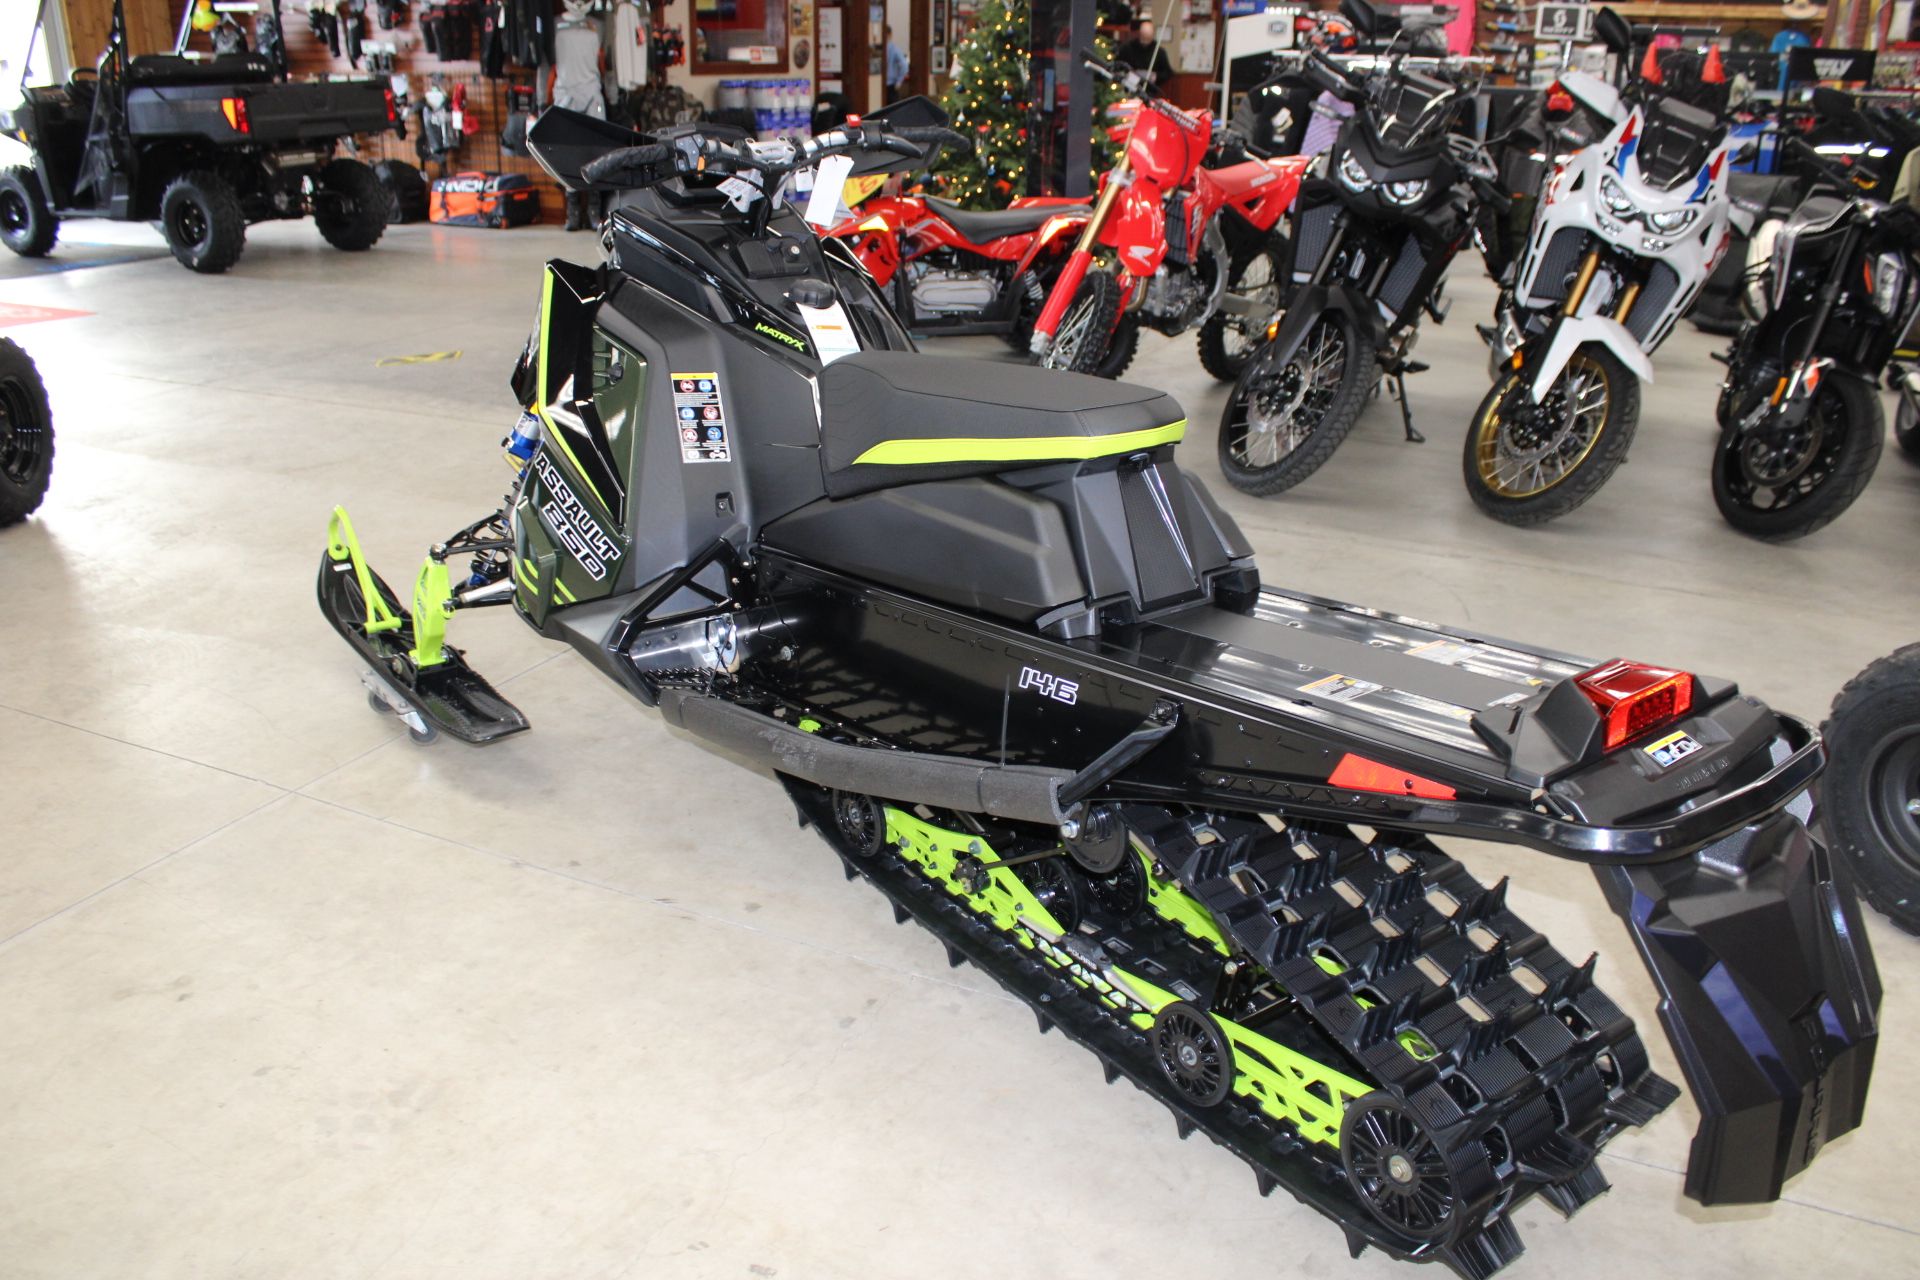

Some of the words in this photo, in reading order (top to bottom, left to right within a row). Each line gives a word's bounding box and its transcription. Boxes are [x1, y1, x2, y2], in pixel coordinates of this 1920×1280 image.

[755, 322, 805, 352] MATRYX
[535, 451, 622, 560] ASSAULT
[541, 501, 607, 581] 850
[1018, 666, 1079, 705] 146
[1066, 945, 1098, 971] POLARIS
